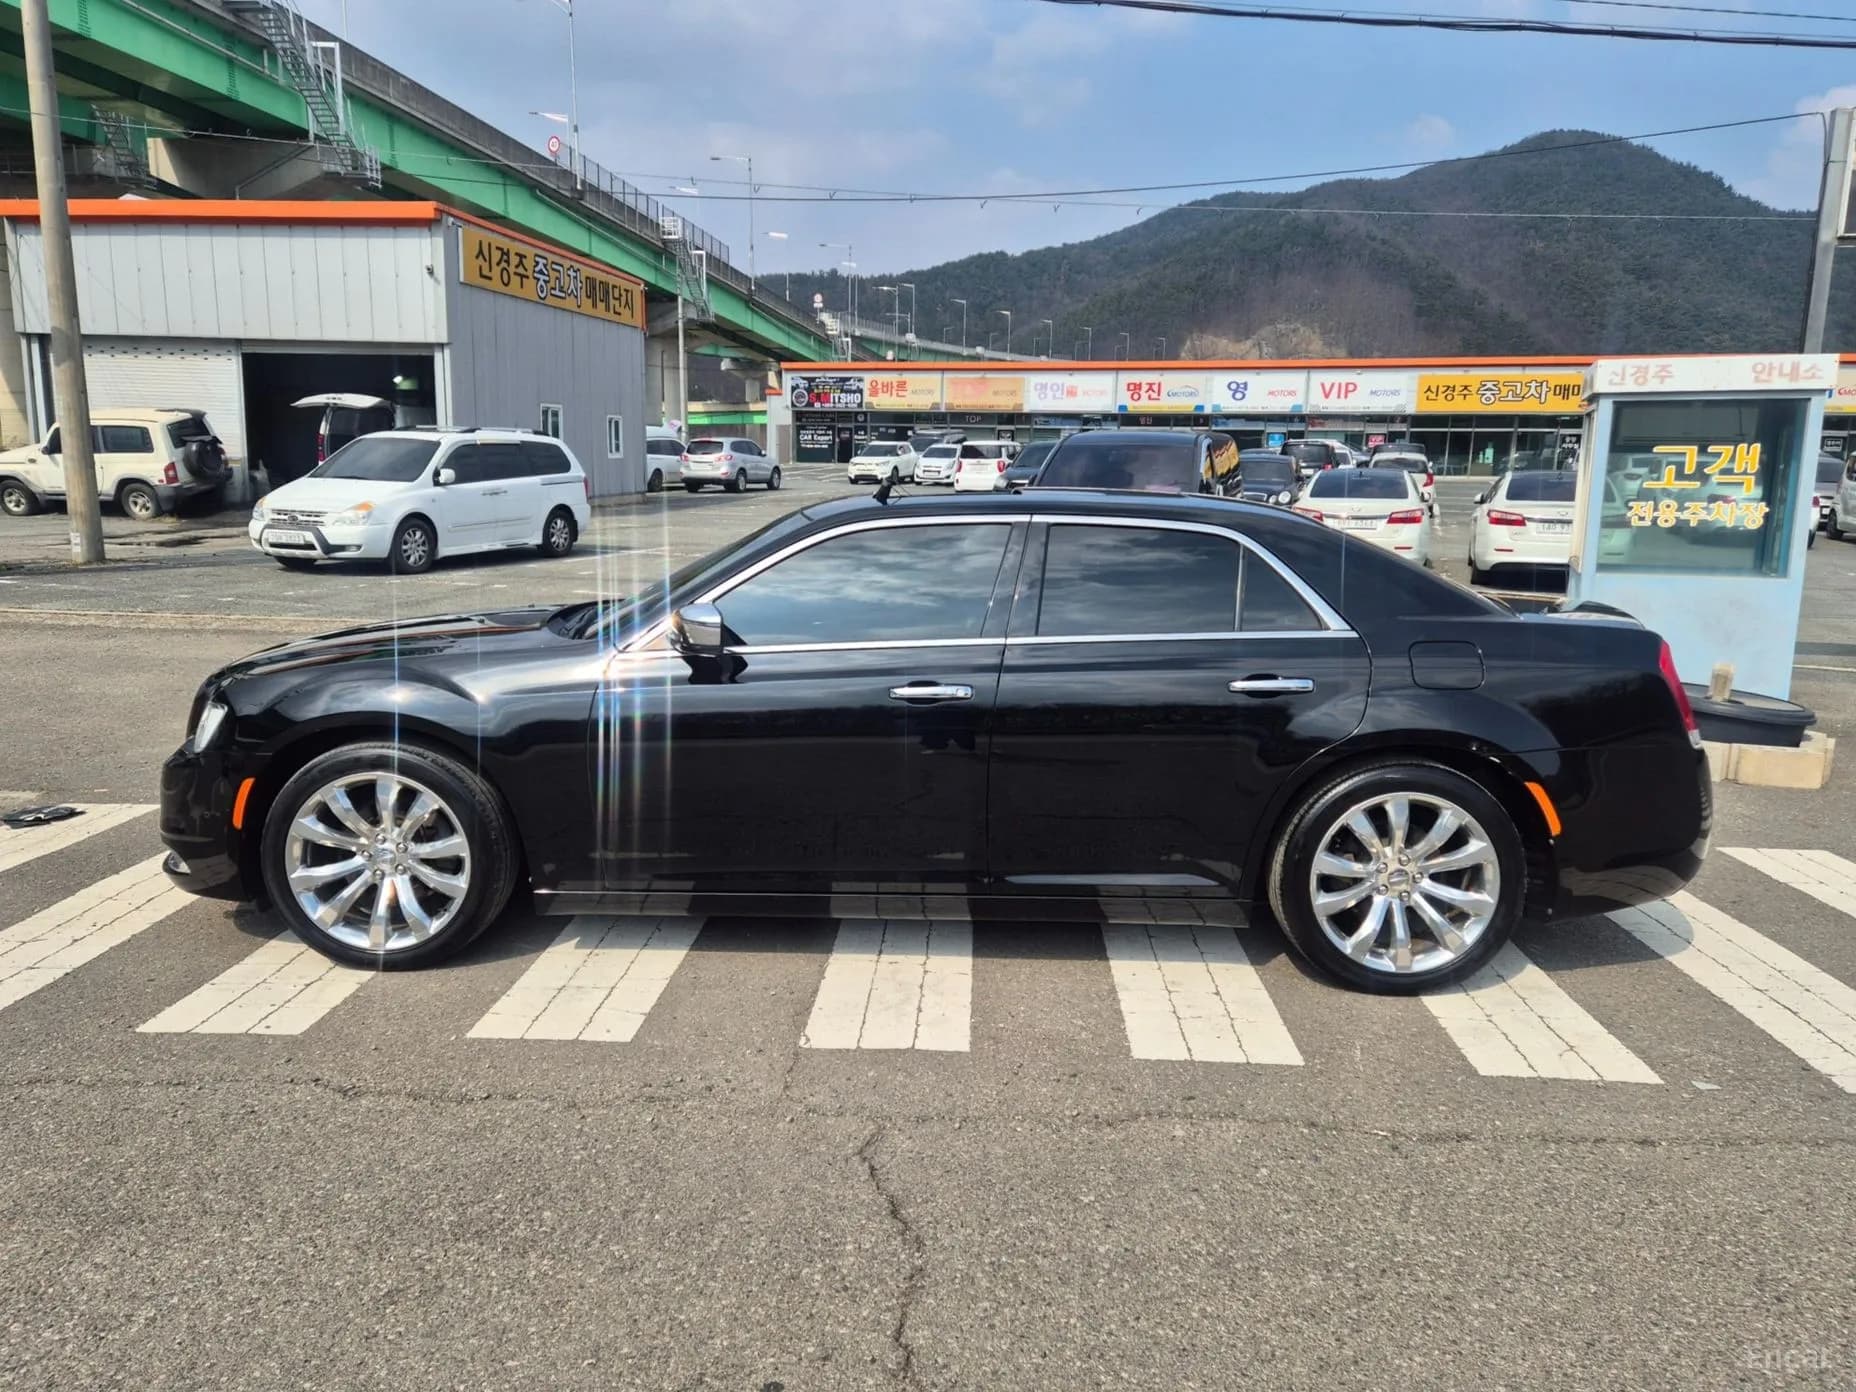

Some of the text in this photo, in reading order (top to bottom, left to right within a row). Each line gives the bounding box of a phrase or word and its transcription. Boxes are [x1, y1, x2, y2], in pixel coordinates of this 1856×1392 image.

[1608, 361, 1824, 386] 신경주 안내소
[868, 379, 909, 398] 올바른
[1033, 381, 1065, 400] 명인
[1126, 381, 1162, 401] 명진
[1227, 380, 1248, 401] 영
[1320, 381, 1401, 400] VIP MOTORS
[1424, 384, 1474, 402] 신경주
[1476, 379, 1551, 405] 중고차
[965, 415, 982, 423] TOP
[813, 434, 833, 442] Export
[1643, 442, 1761, 496] 고객
[1628, 501, 1770, 529] 전용주차장
